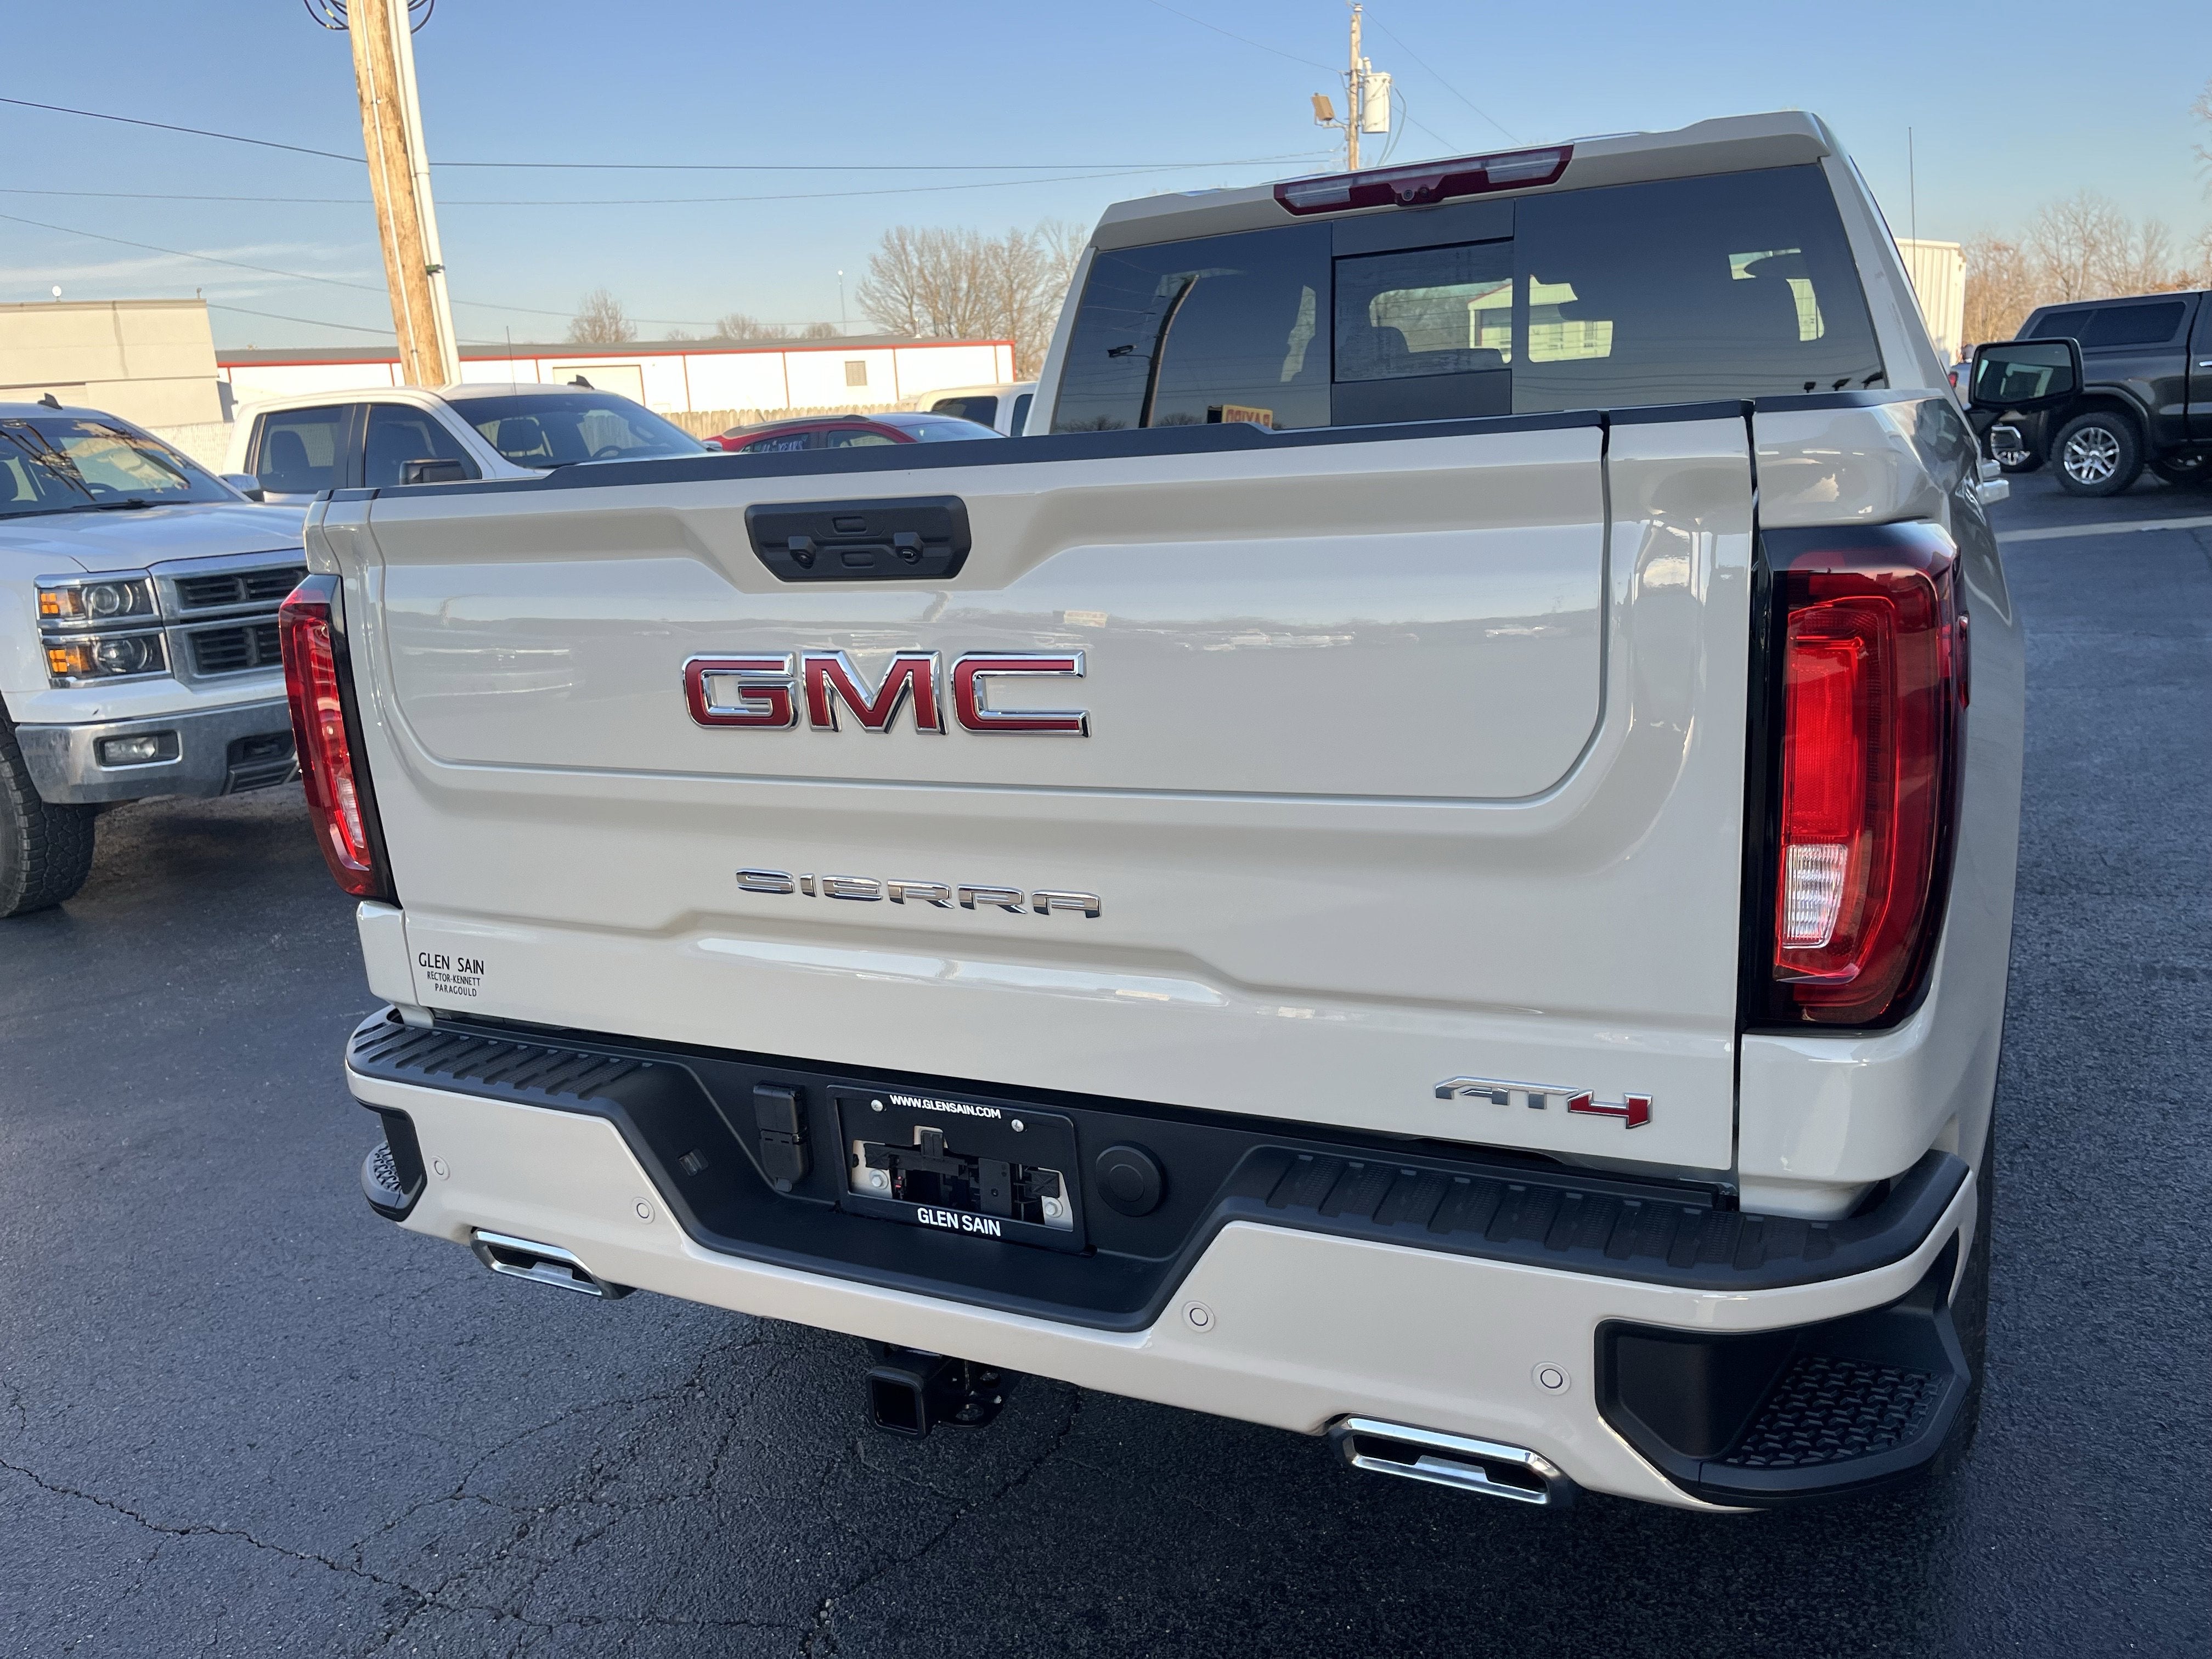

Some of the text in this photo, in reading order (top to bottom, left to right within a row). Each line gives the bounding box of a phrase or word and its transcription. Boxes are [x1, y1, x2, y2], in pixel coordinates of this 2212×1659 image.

[682, 650, 1092, 738] GMC
[735, 868, 1101, 918] SIERRA
[419, 952, 484, 975] GLEN SAIN
[427, 971, 481, 986] RECTOR-KENNETT
[435, 983, 477, 997] PARAGOULD
[890, 1094, 1001, 1119] WWW.GLENSAIN.COM
[1435, 1076, 1652, 1130] AT4
[917, 1207, 1001, 1237] GLEN SAIN
